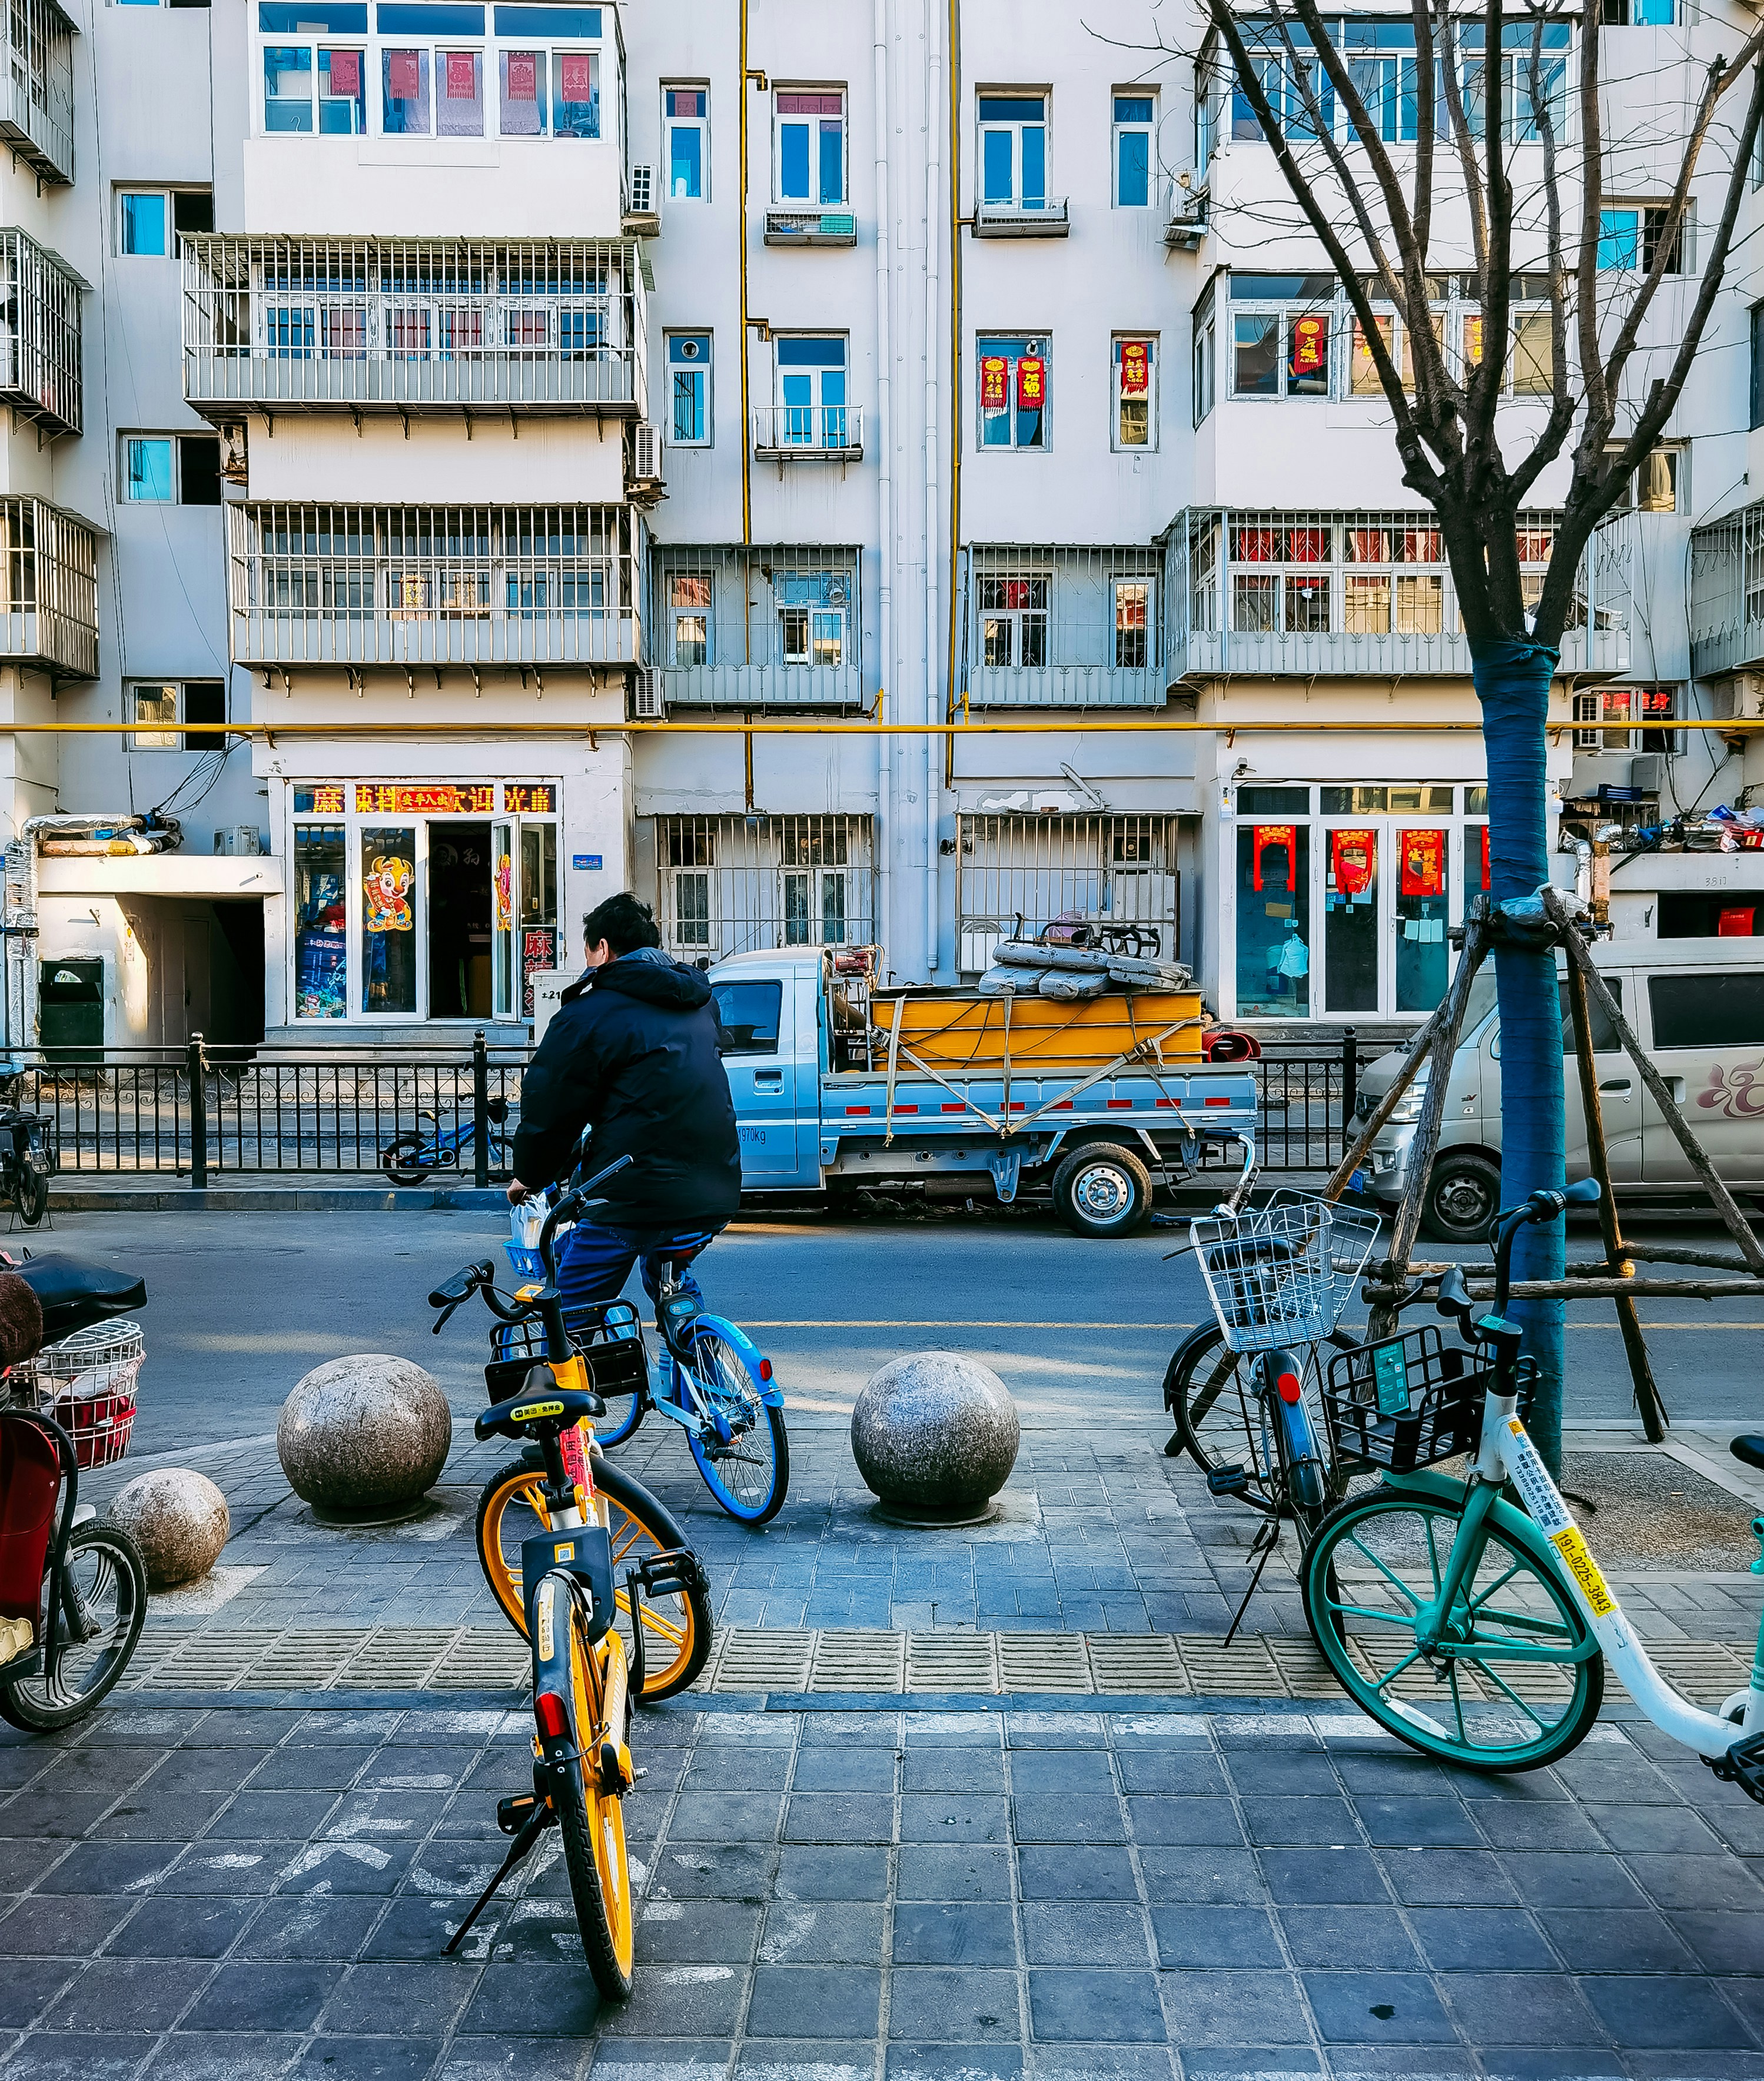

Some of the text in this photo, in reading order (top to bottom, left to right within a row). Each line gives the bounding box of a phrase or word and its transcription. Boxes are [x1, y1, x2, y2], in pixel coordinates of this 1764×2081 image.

[1023, 373, 1040, 394] 福
[738, 1127, 766, 1145] 1970kg
[1514, 1465, 1544, 1514] 13389025118
[1558, 1533, 1611, 1611] 191-0225-3843
